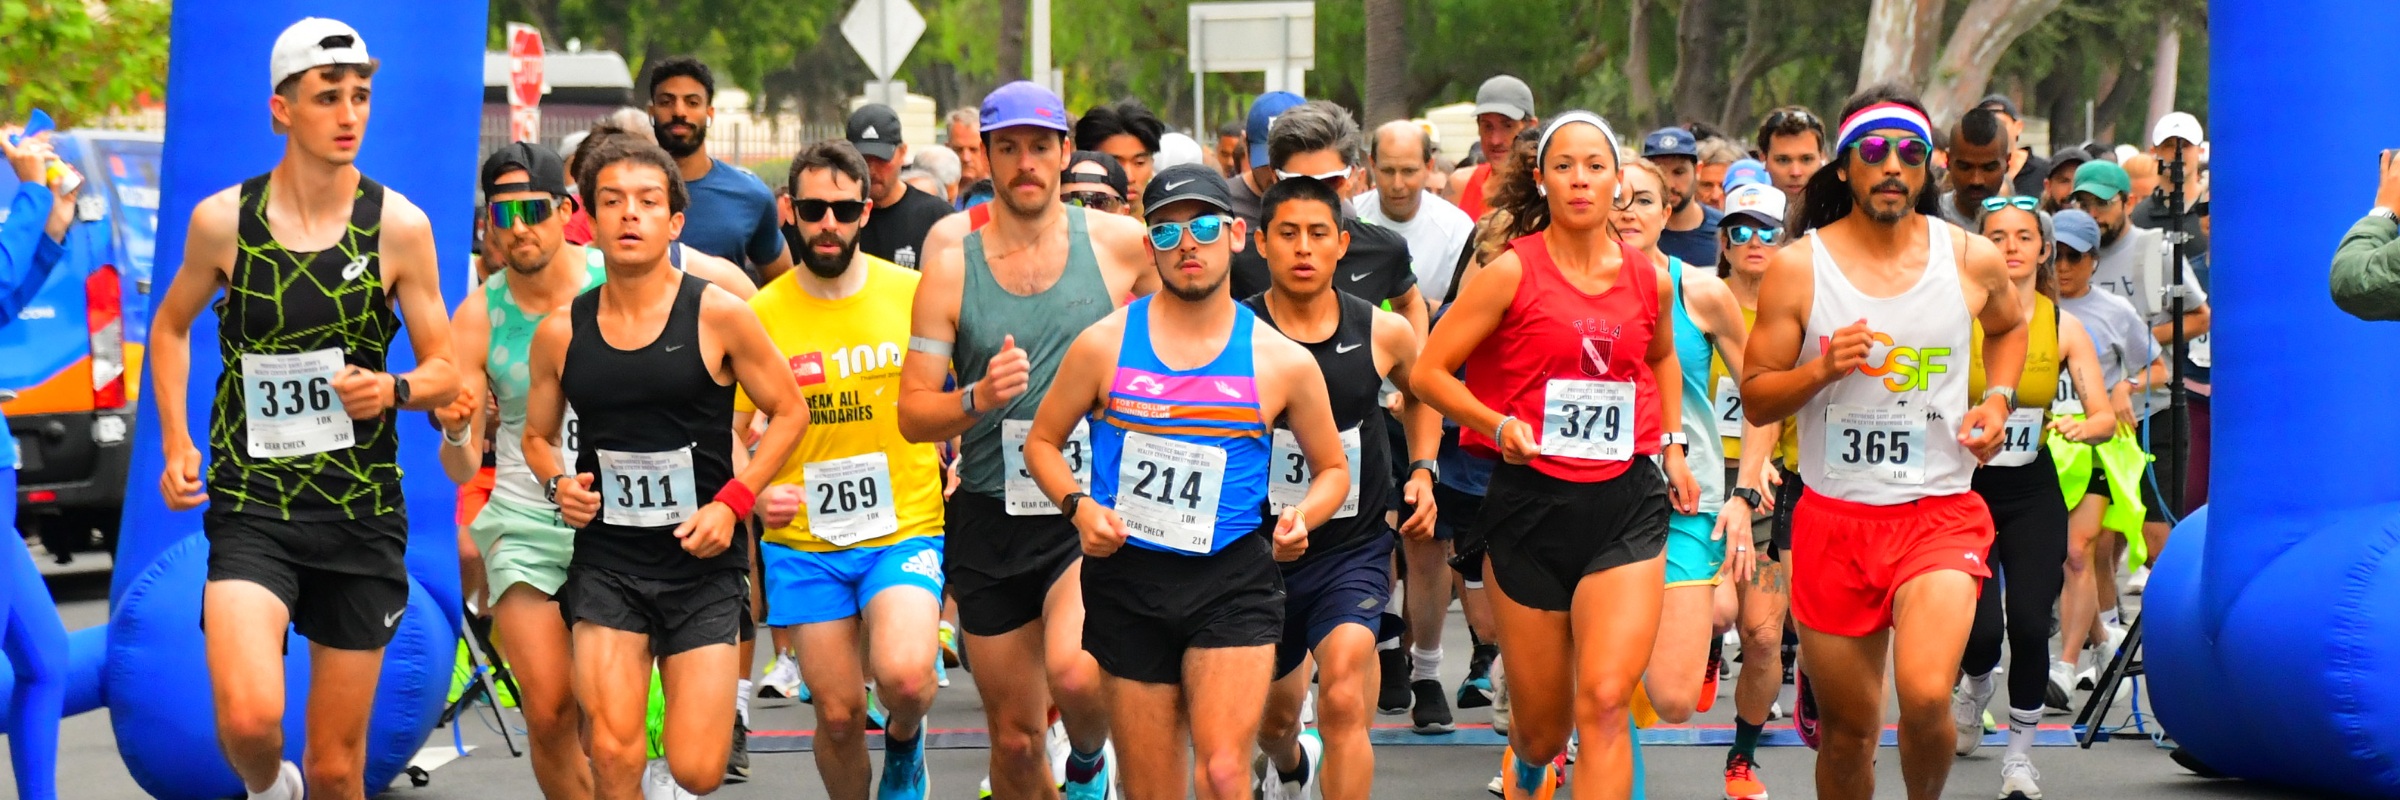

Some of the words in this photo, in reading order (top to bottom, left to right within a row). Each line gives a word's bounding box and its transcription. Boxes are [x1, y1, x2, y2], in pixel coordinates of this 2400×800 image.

[259, 377, 330, 418] 336
[803, 393, 834, 409] REAK
[840, 390, 861, 407] ALL
[316, 416, 332, 425] 10K
[1560, 404, 1620, 442] 379
[334, 433, 349, 442] 336
[264, 442, 281, 450] GEAR
[282, 440, 306, 450] CHECK
[1842, 429, 1910, 465] 365
[1606, 447, 1618, 455] 10K
[1893, 471, 1907, 479] 10K
[1132, 460, 1203, 509] 214
[616, 474, 677, 508] 311
[817, 476, 878, 515] 269
[1021, 501, 1037, 509] GEAR
[666, 511, 680, 520] 10K
[866, 512, 879, 520] 10K
[1181, 514, 1196, 524] 10K
[1126, 519, 1142, 531] GEAR
[1143, 525, 1165, 537] CHECK
[1192, 536, 1207, 546] 214
